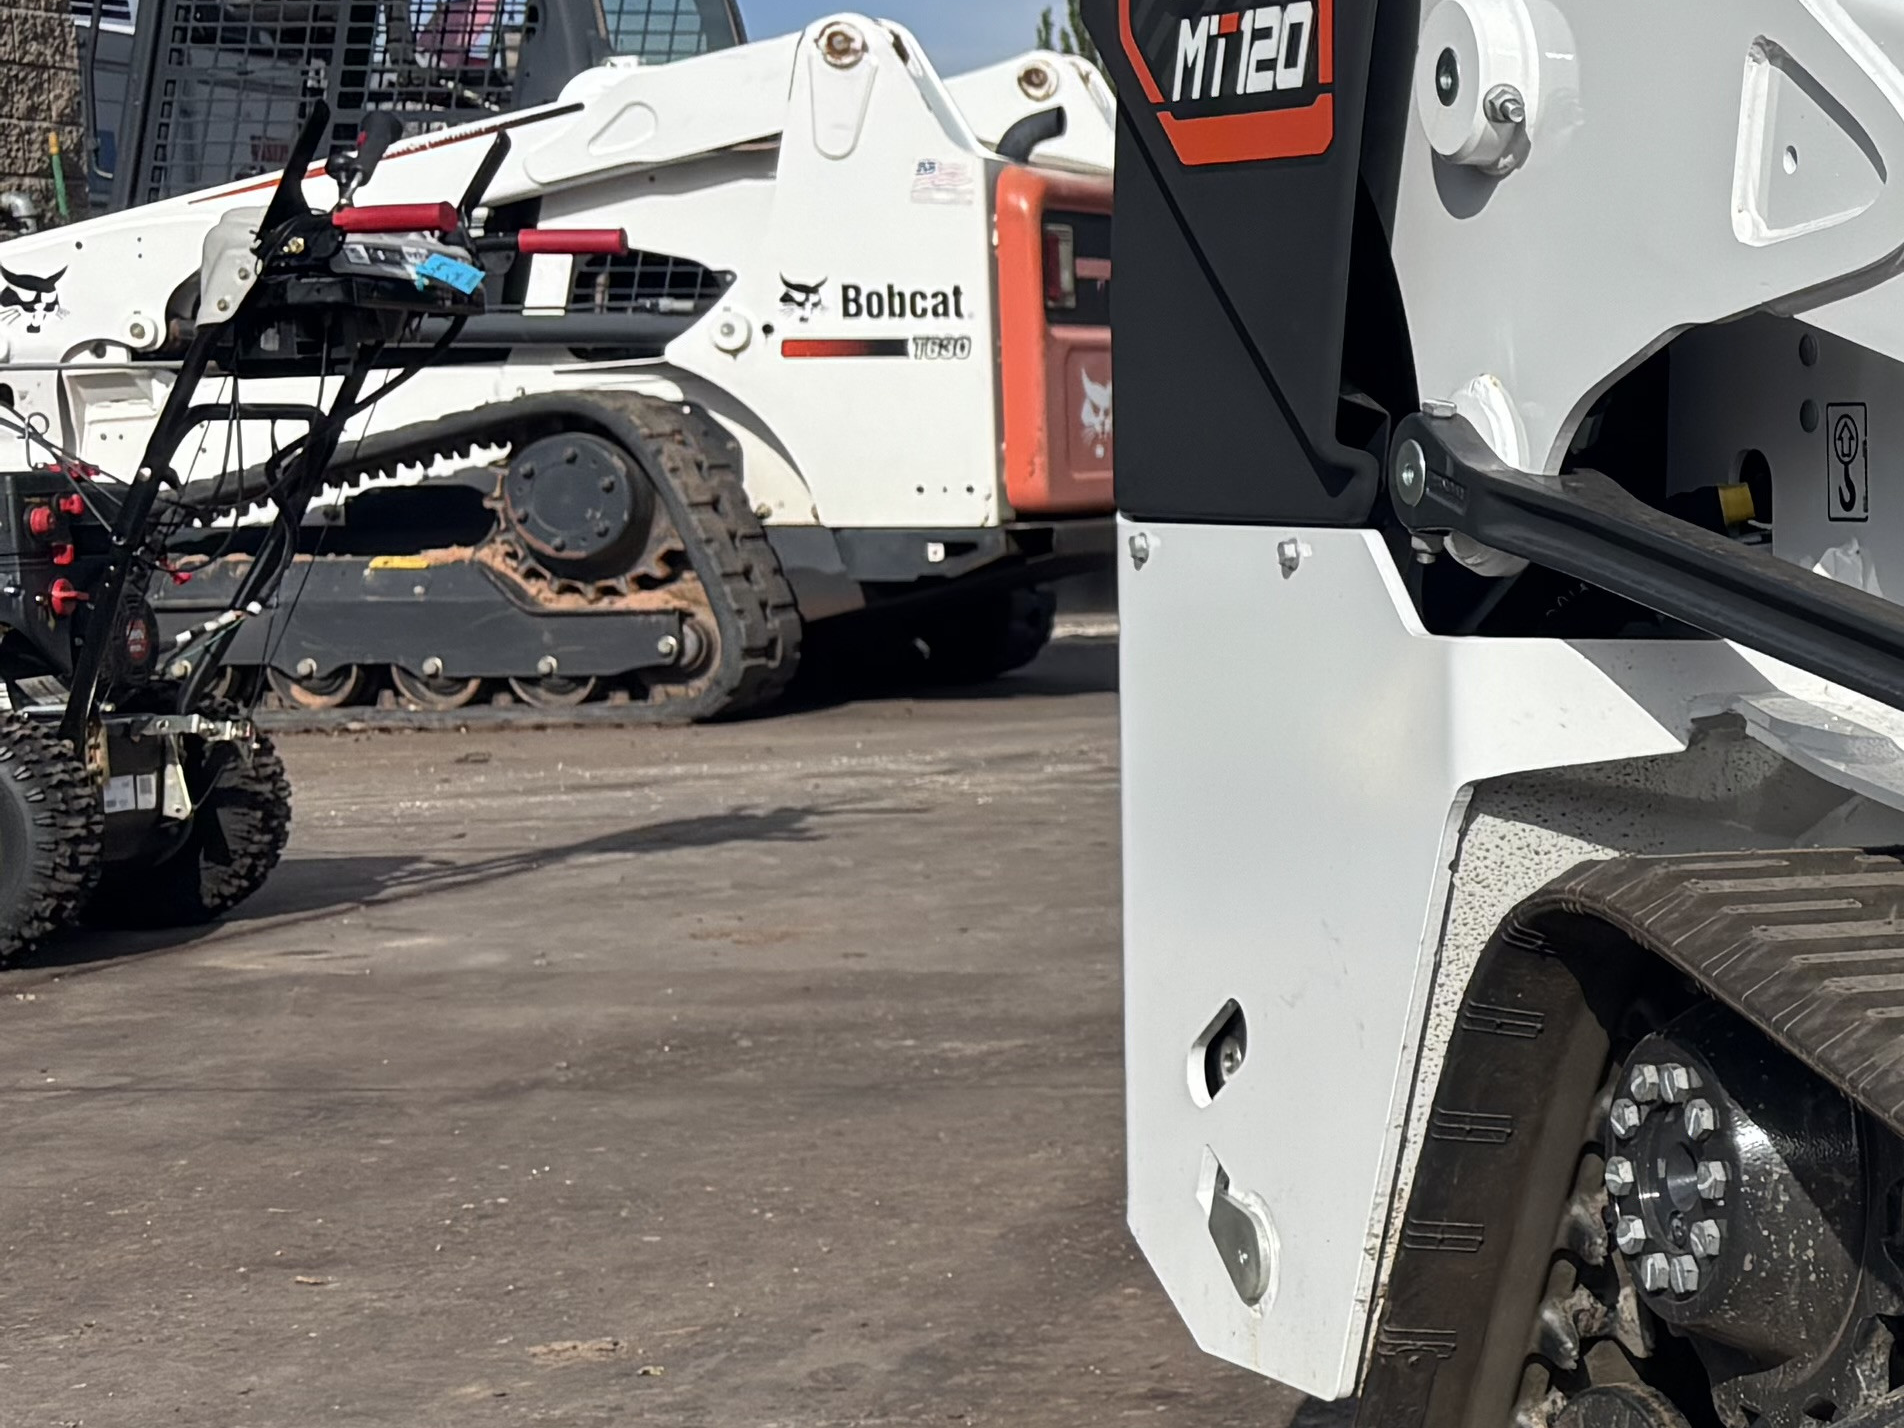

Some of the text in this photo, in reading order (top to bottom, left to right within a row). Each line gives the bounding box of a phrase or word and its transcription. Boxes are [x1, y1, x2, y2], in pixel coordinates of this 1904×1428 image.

[1172, 0, 1313, 102] MT120
[842, 283, 964, 320] Bobcat
[912, 336, 972, 360] T630
